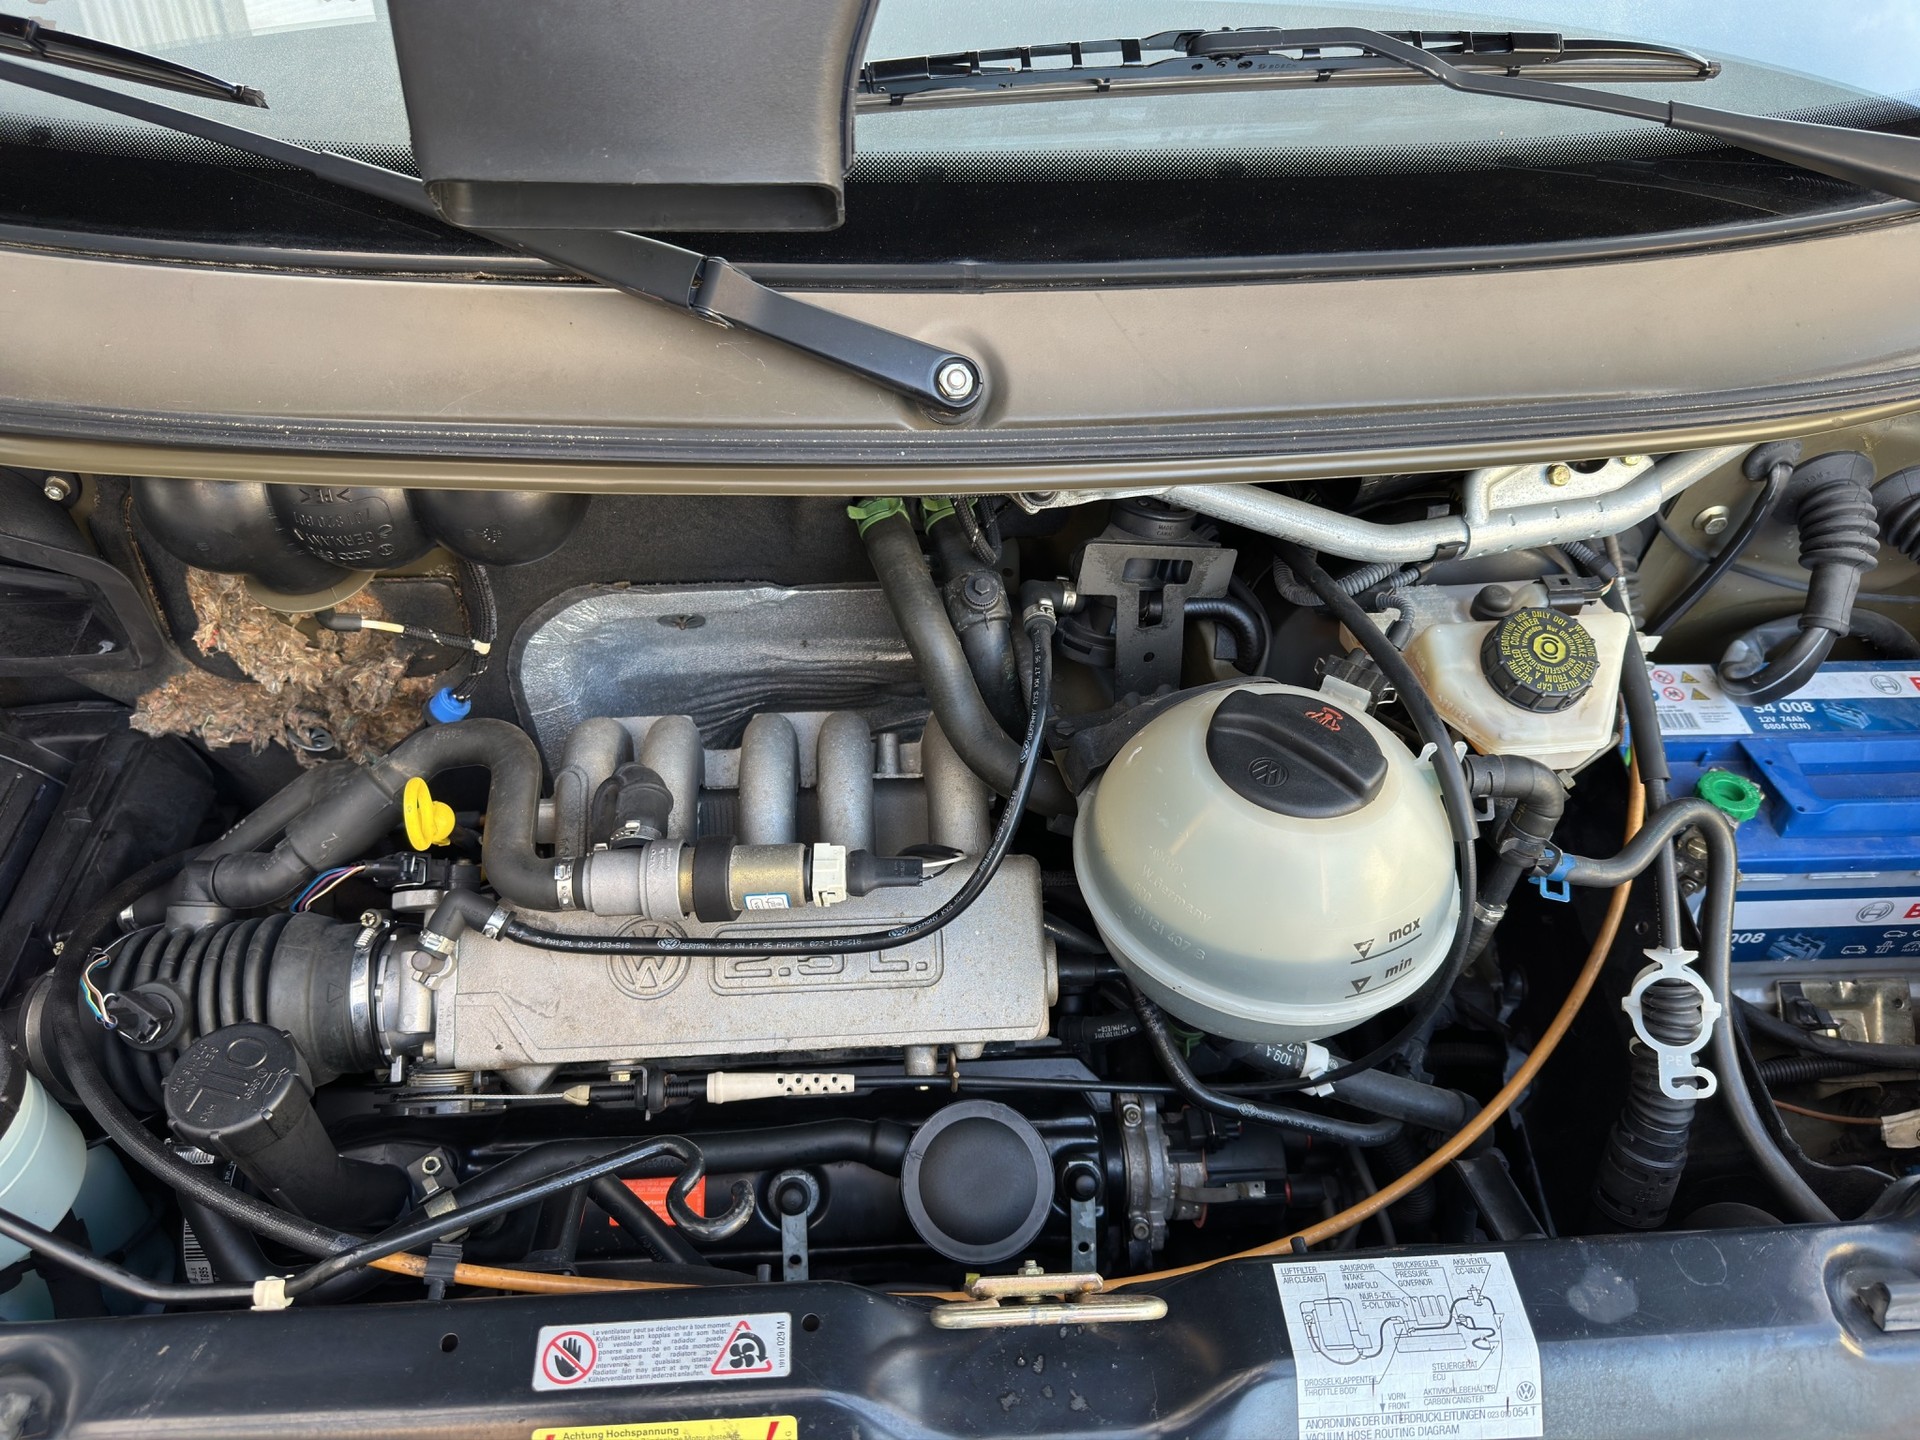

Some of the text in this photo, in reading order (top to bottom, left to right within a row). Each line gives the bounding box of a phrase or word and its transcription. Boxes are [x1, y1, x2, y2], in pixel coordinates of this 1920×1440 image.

[1515, 612, 1529, 622] USE
[1531, 611, 1550, 619] ONLY
[1553, 616, 1568, 627] DOT
[1510, 618, 1540, 646] CONTAINER
[1501, 621, 1516, 656] REMOVING
[1546, 624, 1558, 633] Nur
[1559, 631, 1577, 656] ORIGINAL
[1574, 624, 1595, 657] WARNING
[1572, 634, 1587, 658] BRAKE
[1512, 649, 1532, 672] SEALED
[1507, 659, 1533, 684] BEFORE
[1569, 660, 1585, 677] FLUID
[1581, 660, 1595, 680] CLEAN
[1535, 671, 1541, 679] A
[1545, 674, 1568, 683] FROM
[1537, 682, 1552, 691] CAP
[1557, 679, 1580, 691] FILLER
[1779, 701, 1816, 713] 008
[1790, 722, 1811, 730] (EN)
[1389, 917, 1420, 943] max
[578, 941, 631, 949] 023-133-518
[1385, 958, 1412, 978] min
[1392, 1259, 1440, 1269] DRUCKREGLER
[1453, 1257, 1490, 1265] AKB-VENTIL
[1280, 1265, 1317, 1275] LUFTFILTER
[1340, 1263, 1375, 1272] SAUGROHR
[1455, 1267, 1486, 1275] CC-VALVE
[1342, 1273, 1365, 1281] INTAKE
[1395, 1269, 1429, 1278] PRESSURE
[1283, 1275, 1325, 1285] AIR CLEANER
[1398, 1279, 1433, 1287] GOVERNOR
[1344, 1282, 1379, 1290] MANIFOLD
[1360, 1292, 1374, 1300] NUR
[1384, 1300, 1400, 1309] ONLY
[601, 1327, 632, 1336] ventilateur
[633, 1327, 647, 1335] peut
[656, 1324, 688, 1332] déclencher
[707, 1321, 732, 1329] moment.
[776, 1321, 785, 1330] M
[634, 1332, 645, 1340] kan
[648, 1331, 670, 1340] kopplas
[671, 1336, 696, 1344] radiador
[706, 1335, 724, 1343] puede
[776, 1331, 785, 1346] 029
[599, 1348, 622, 1357] ponerse
[637, 1345, 660, 1353] marcha
[611, 1353, 643, 1361] ventilatore
[670, 1350, 697, 1358] radiatore
[593, 1368, 618, 1376] Radiator
[635, 1366, 648, 1374] may
[680, 1363, 690, 1371] any
[588, 1373, 635, 1383] Kühlerventilator
[636, 1372, 650, 1380] kann
[650, 1371, 678, 1380] jederzeit
[1304, 1387, 1358, 1397] THROTTLE BODY
[1387, 1392, 1406, 1401] VORN
[1423, 1395, 1485, 1406] CARBON CANISTER
[1388, 1402, 1410, 1410] FRONT
[1306, 1416, 1361, 1430] ANORDNUNG
[1362, 1415, 1380, 1426] DER
[1381, 1409, 1486, 1425] UNTERDRUCKLEITUNGEN
[1487, 1411, 1499, 1419] 023
[1512, 1407, 1529, 1417] 054
[1530, 1406, 1537, 1416] T
[563, 1428, 679, 1440] Achtung Hochspannung
[1306, 1424, 1460, 1440] VACUUM HOSE ROUTING DIAGRAM
